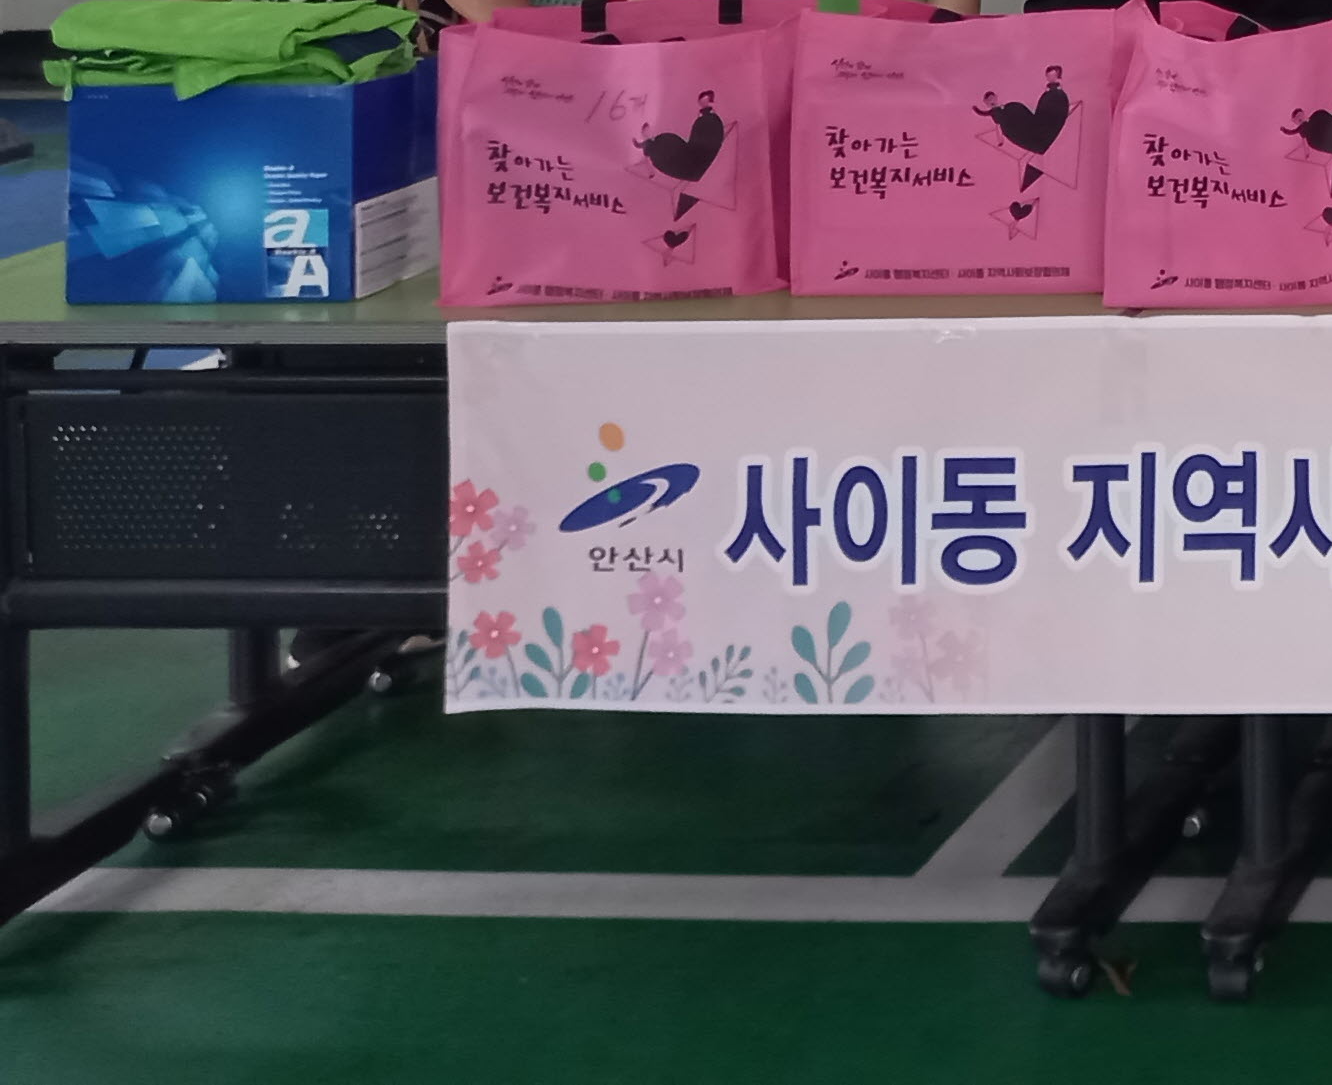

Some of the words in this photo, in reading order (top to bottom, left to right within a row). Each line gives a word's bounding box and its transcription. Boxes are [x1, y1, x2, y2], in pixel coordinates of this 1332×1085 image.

[487, 138, 575, 180] 찾아가는
[824, 124, 919, 159] 찾아가는
[1142, 134, 1230, 175] 찾아가는
[487, 180, 628, 217] 보건복지서비스
[828, 164, 976, 199] 보건복지서비스
[1145, 175, 1288, 210] 보건복지서비스
[723, 454, 1028, 587] 사이동
[588, 545, 686, 574] 안산시
